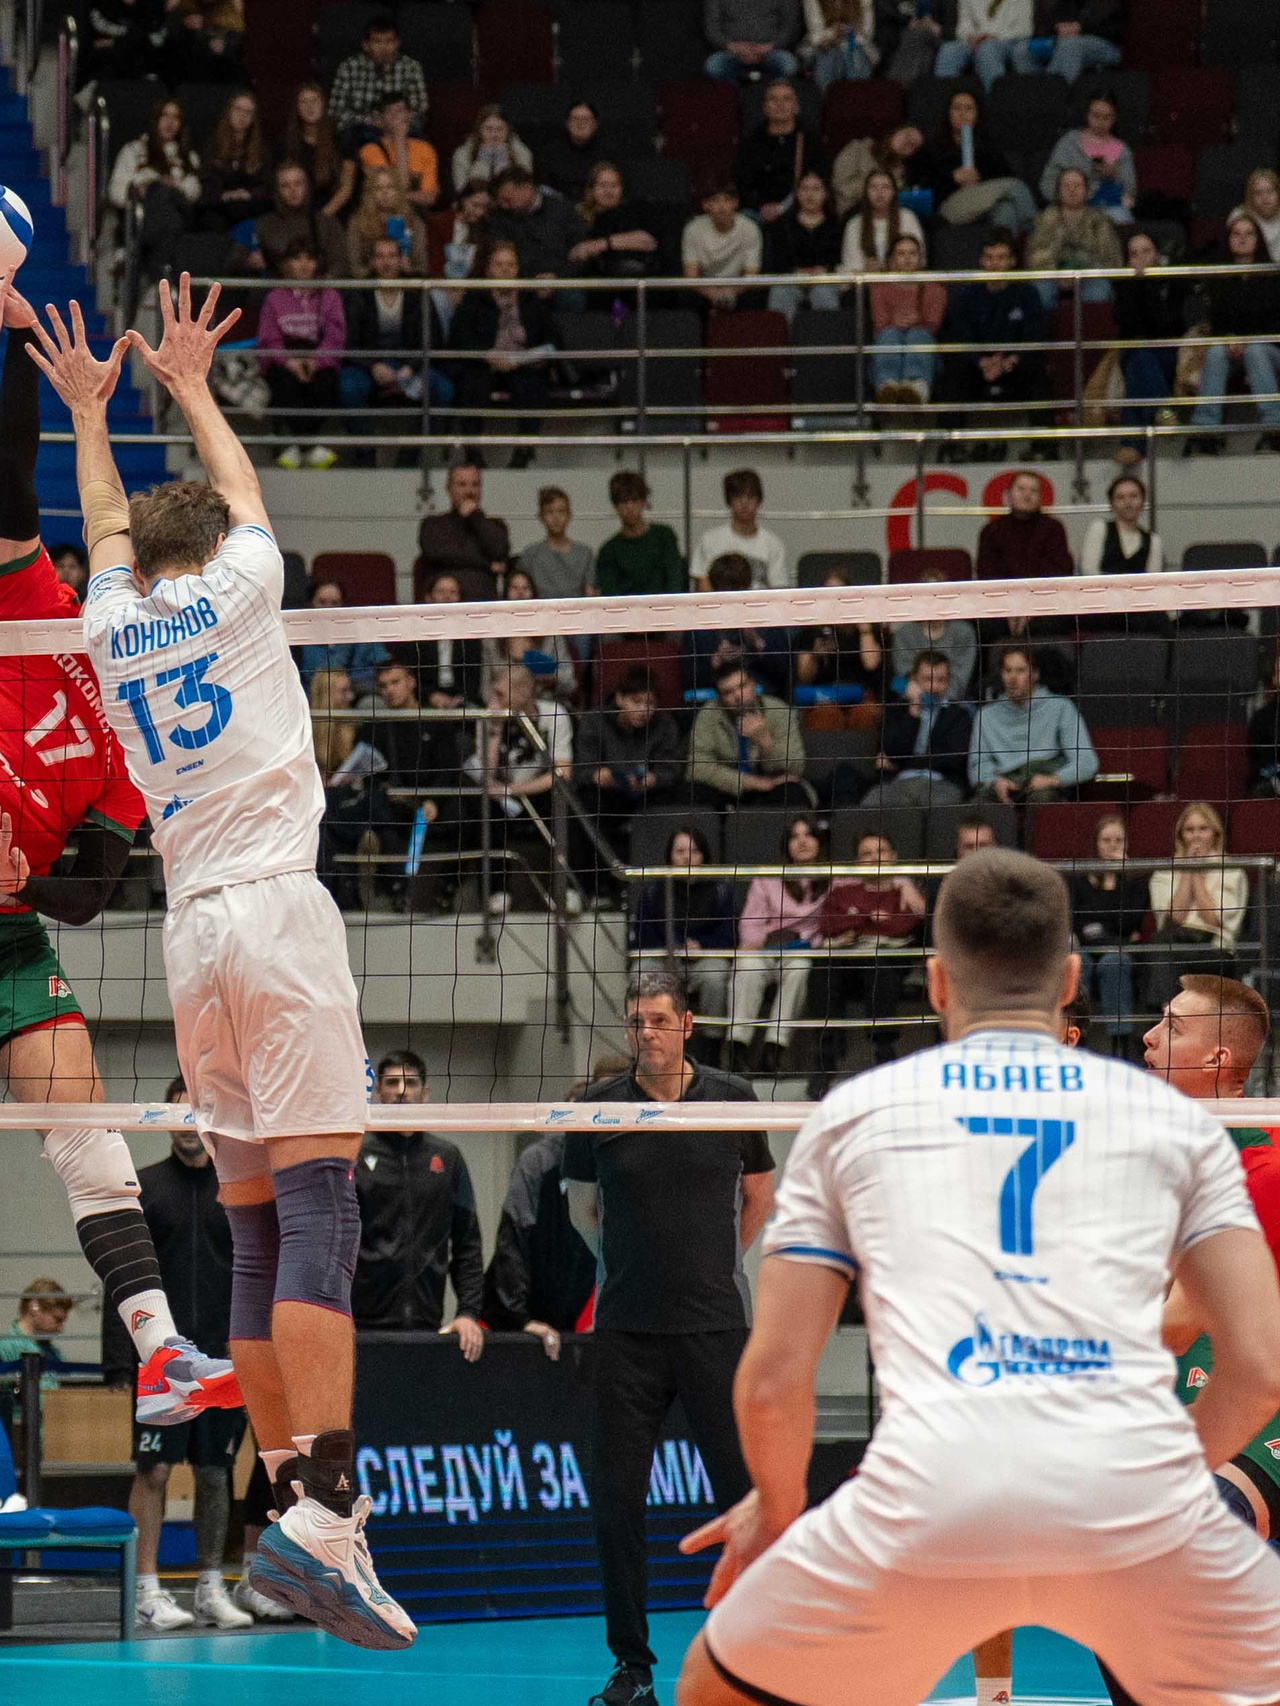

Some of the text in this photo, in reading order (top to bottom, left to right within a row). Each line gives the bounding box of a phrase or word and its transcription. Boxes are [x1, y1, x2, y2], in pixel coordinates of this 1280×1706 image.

[111, 596, 218, 659] КОНОНОВ
[24, 689, 95, 767] 17
[115, 651, 233, 766] 13
[176, 758, 204, 775] ENSEN
[942, 1063, 1084, 1091] АБАЕВ
[954, 1116, 1075, 1257] 7
[139, 1431, 162, 1452] 24
[355, 1429, 528, 1524] СЛЕДУЙ
[532, 1442, 590, 1510] ЗА
